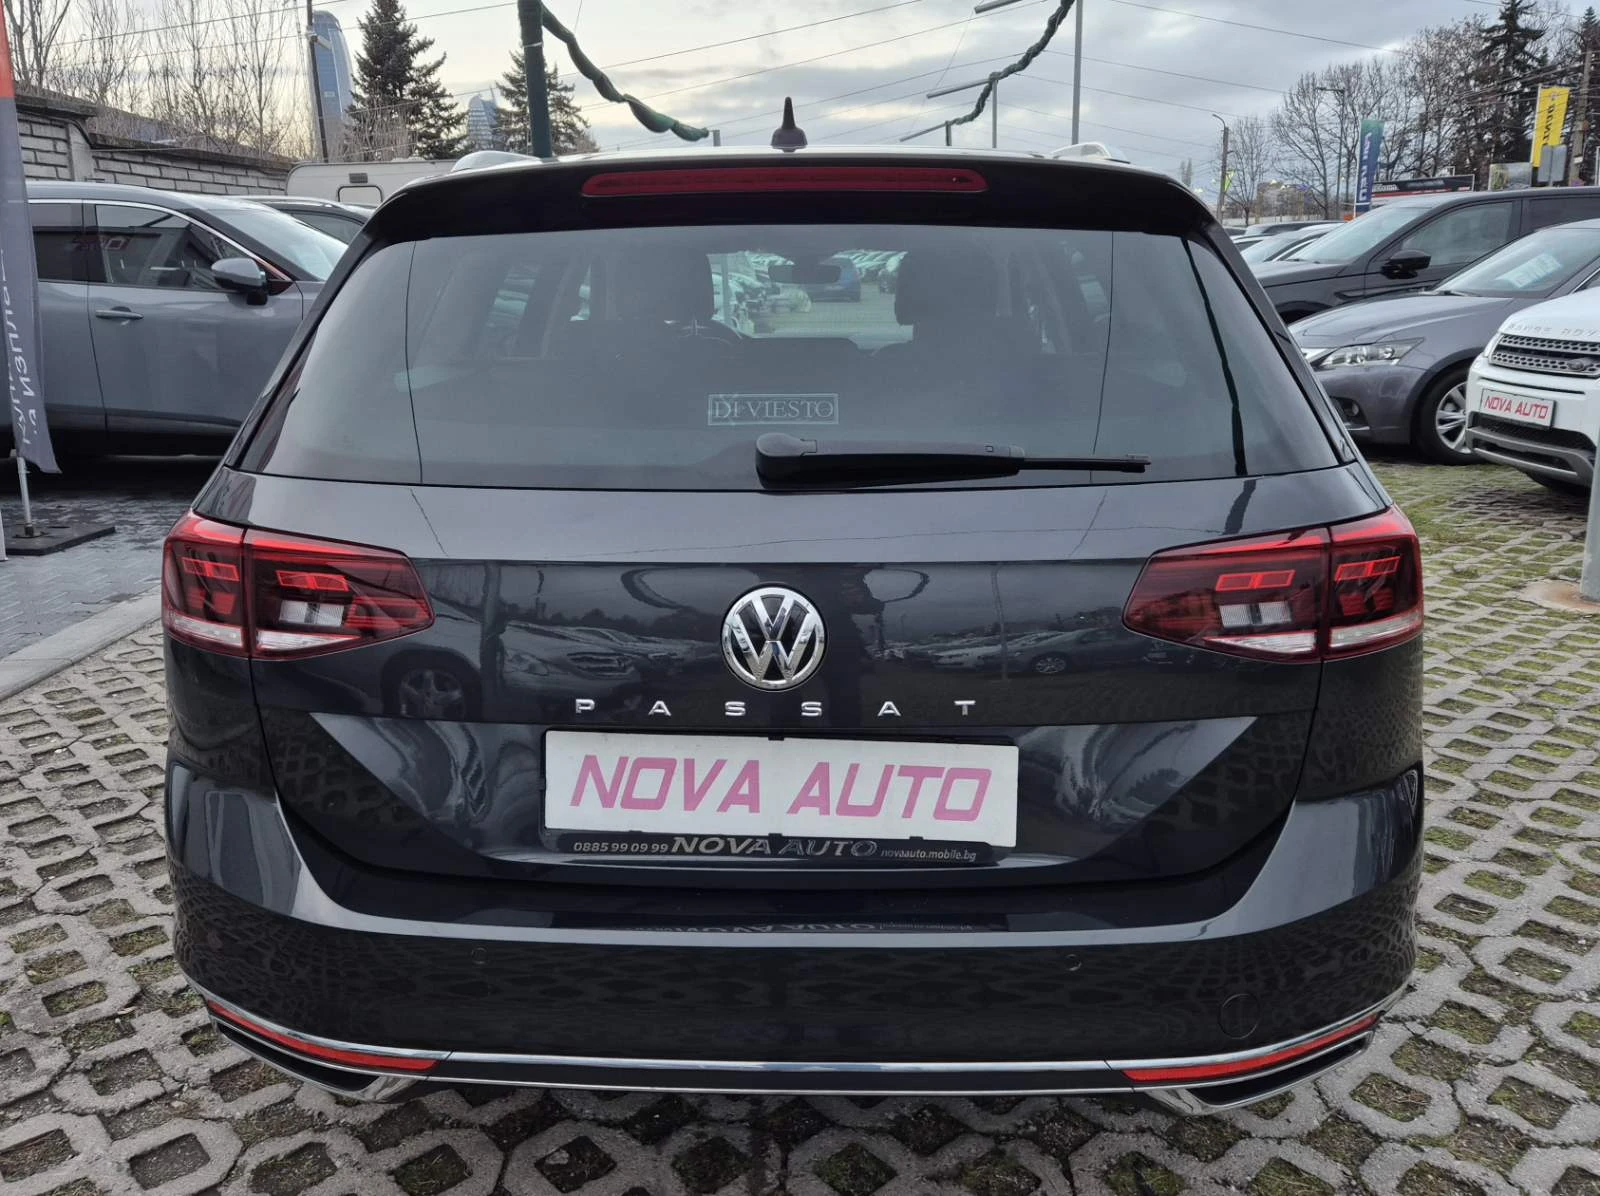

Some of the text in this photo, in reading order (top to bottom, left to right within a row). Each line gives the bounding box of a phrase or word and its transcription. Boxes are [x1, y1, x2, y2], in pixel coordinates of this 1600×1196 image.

[1485, 396, 1549, 419] NOVA AUTO
[575, 698, 976, 717] PASSAT
[569, 754, 992, 822] NOVA AUTO
[671, 836, 772, 855] NOVA
[778, 838, 878, 857] AUTO
[881, 849, 977, 862] novaauto.mobile.bg
